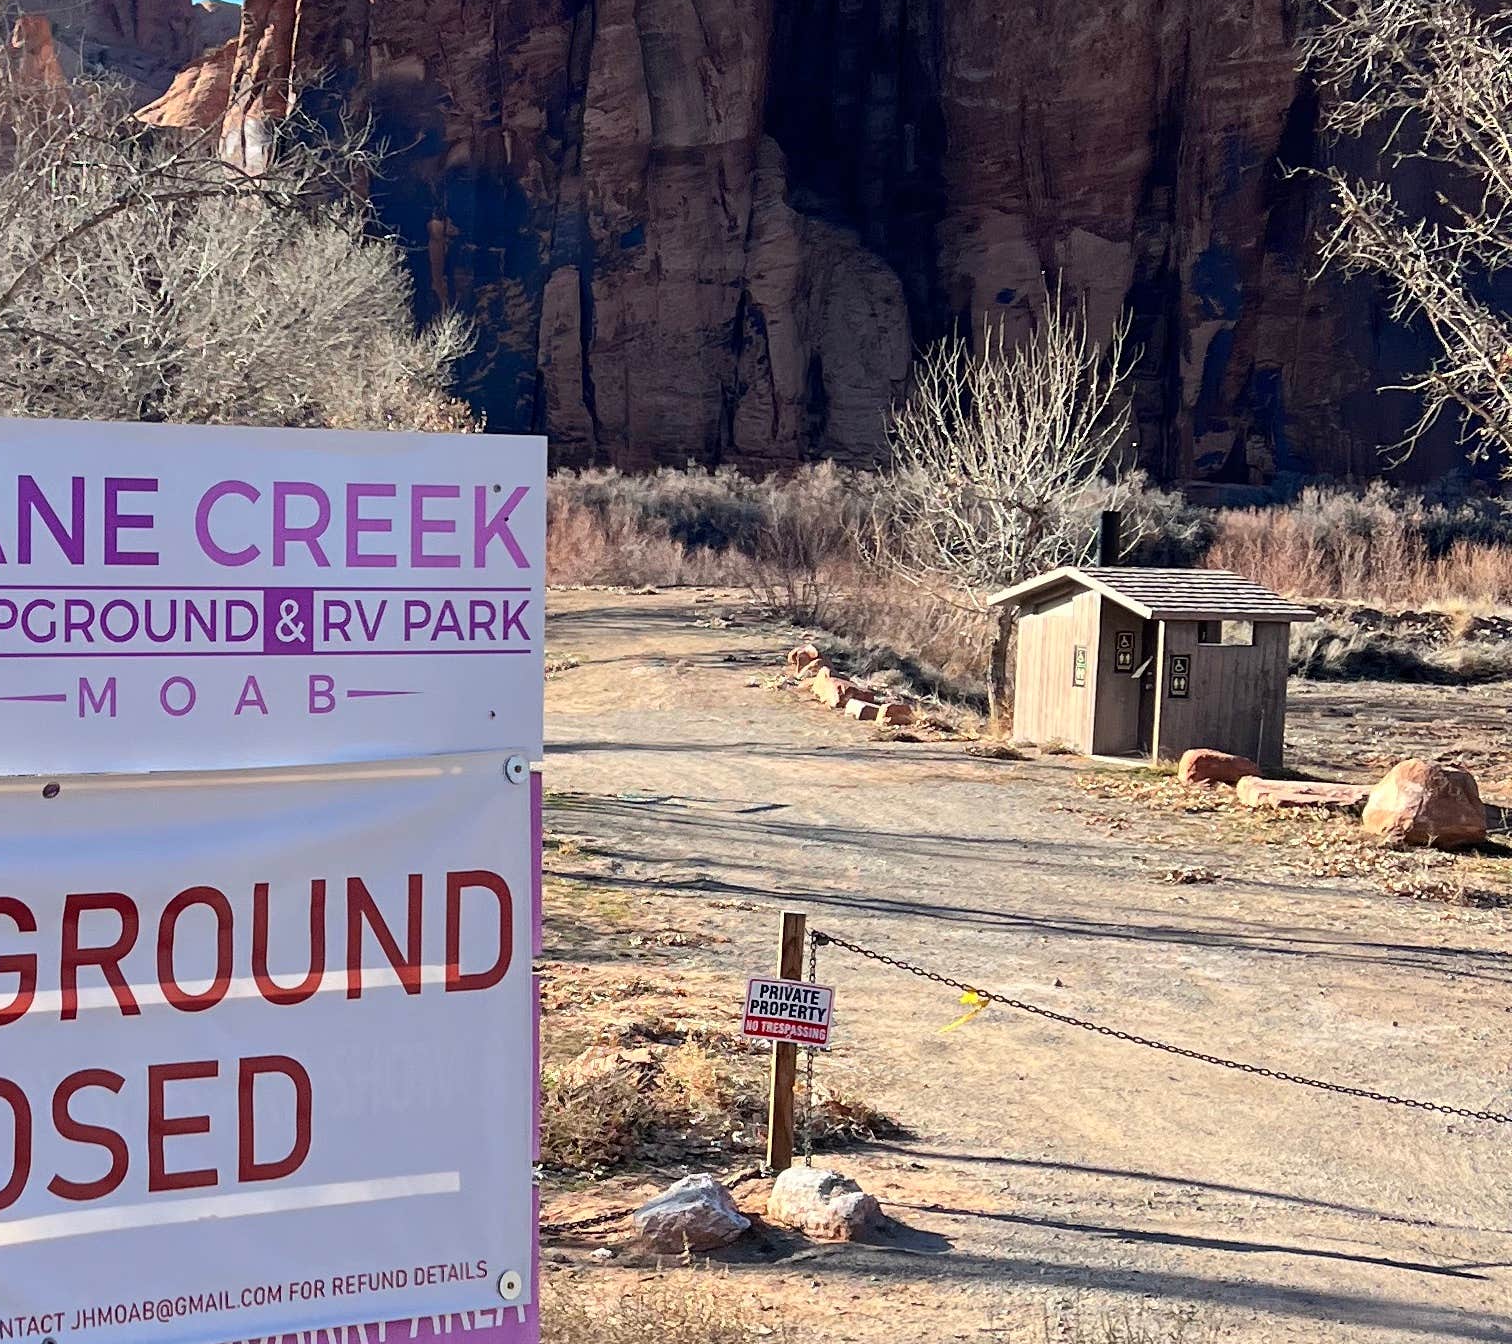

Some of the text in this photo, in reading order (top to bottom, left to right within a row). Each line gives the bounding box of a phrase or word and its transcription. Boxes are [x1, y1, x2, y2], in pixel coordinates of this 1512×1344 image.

[195, 480, 530, 568] CREEK
[276, 600, 305, 642] &
[323, 600, 387, 641] RV
[405, 600, 531, 641] PARK
[79, 675, 335, 718] MOAB
[749, 999, 827, 1022] PROPERTY
[760, 984, 821, 1005] PRIVATE
[746, 1020, 827, 1040] NO TRESPASSING
[72, 1285, 281, 1329] JHMOAB@GMAIL.COM
[290, 1280, 325, 1301] FOR
[333, 1270, 407, 1296] REFUND
[414, 1260, 487, 1285] DETAILS
